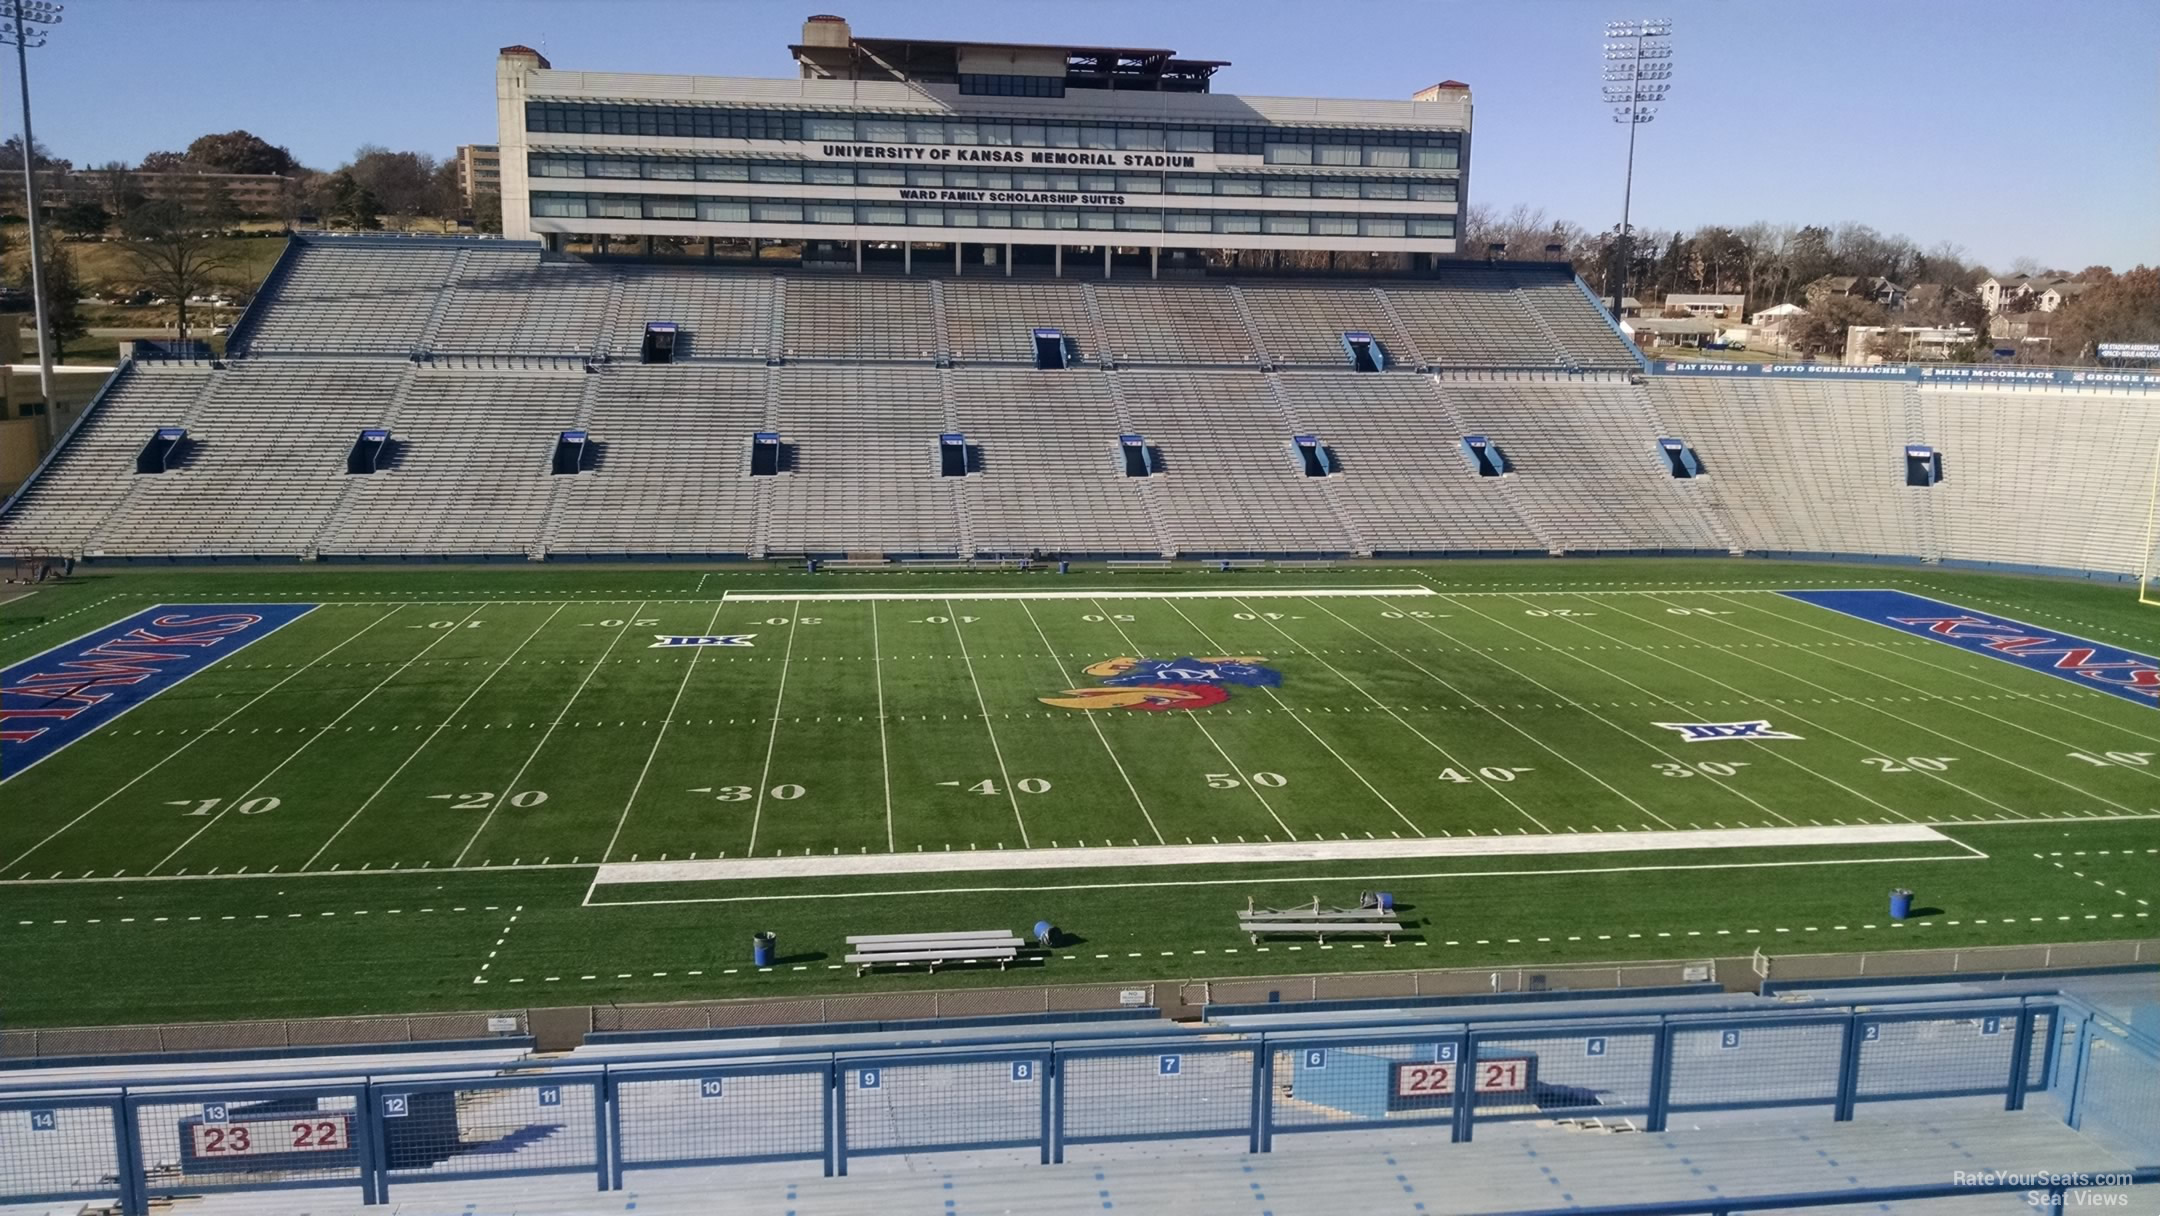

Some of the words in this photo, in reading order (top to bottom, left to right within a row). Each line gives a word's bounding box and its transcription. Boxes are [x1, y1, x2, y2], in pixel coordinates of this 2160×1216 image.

[823, 145, 926, 160] UNIVERSITY
[929, 148, 951, 161] OF
[957, 149, 1024, 163] KANSAS
[1031, 152, 1117, 166] MEMORIAL
[1123, 154, 1195, 168] STADIUM
[899, 189, 937, 200] WARD
[940, 190, 985, 202] FAMILY
[989, 191, 1078, 204] SCHOLARSHIP
[1081, 194, 1125, 205] SUITES
[1677, 363, 1697, 371] RAY
[1773, 365, 1805, 373] OTTO
[1808, 366, 1907, 374] SCHNELLBACHER
[1935, 368, 1970, 376] MIKE
[1972, 370, 2055, 379] McCORMACK
[2086, 373, 2140, 382] GEORGE
[1082, 614, 1136, 622] 50
[1860, 755, 1950, 773] 20
[2066, 750, 2150, 767] 10
[1438, 766, 1516, 784] 40
[1651, 761, 1738, 778] 30
[967, 777, 1053, 796] 40
[1204, 771, 1289, 790] 50
[714, 783, 806, 801] 30
[181, 796, 282, 817] 10
[449, 790, 549, 810] 20
[1866, 1026, 1876, 1039] 2
[1986, 1020, 1994, 1032] 1
[1725, 1032, 1736, 1046] 3
[1440, 1046, 1450, 1059] 5
[1590, 1040, 1600, 1053] 4
[1164, 1058, 1175, 1071] 7
[1310, 1052, 1320, 1065] 6
[1016, 1064, 1028, 1078] 8
[1410, 1068, 1448, 1091] 22
[1485, 1065, 1517, 1088] 21
[864, 1072, 875, 1086] 9
[703, 1081, 720, 1095] 10
[540, 1089, 556, 1103] 11
[385, 1097, 403, 1113] 12
[32, 1112, 52, 1127] 14
[206, 1105, 225, 1120] 13
[203, 1126, 251, 1152] 23
[292, 1121, 338, 1148] 22
